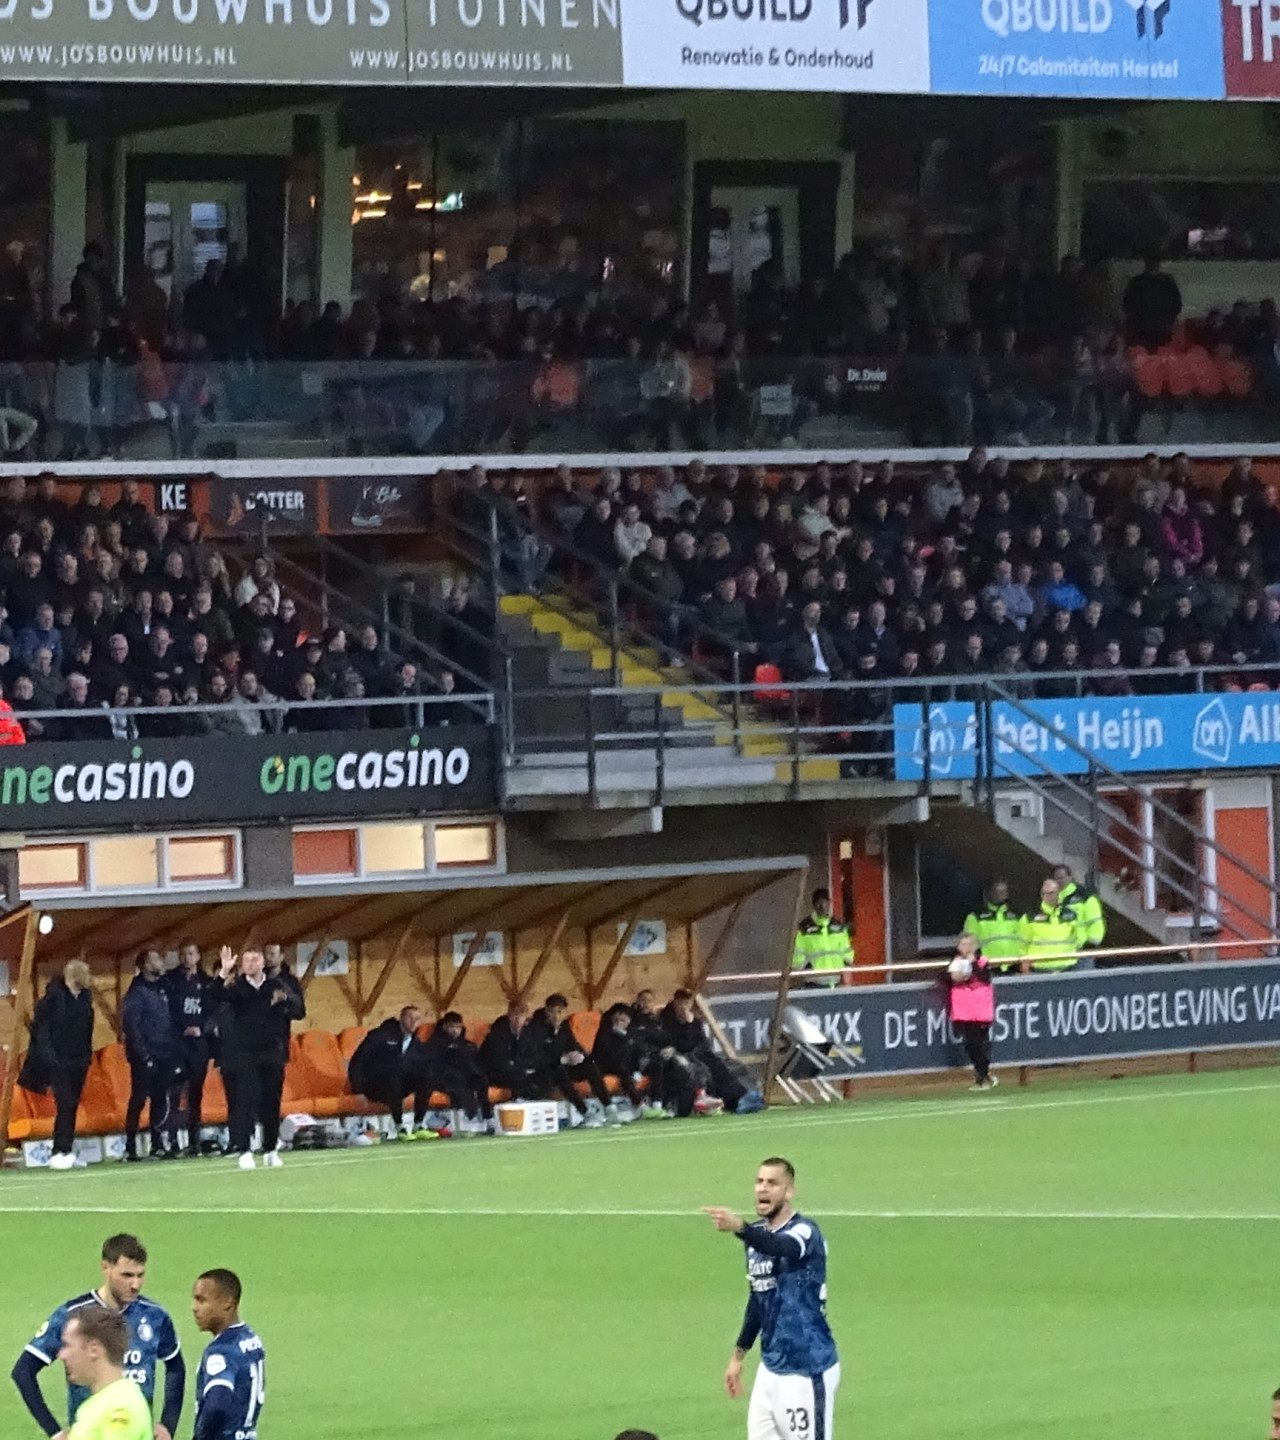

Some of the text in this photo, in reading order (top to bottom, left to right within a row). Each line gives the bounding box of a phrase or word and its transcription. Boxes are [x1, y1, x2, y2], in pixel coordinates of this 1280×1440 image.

[981, 0, 1112, 36] QBUILD
[681, 46, 873, 69] Renovatie & Onderhoud
[161, 484, 187, 510] KE
[962, 714, 1066, 756] Abert
[1077, 708, 1164, 760] Heijn
[260, 734, 470, 796] onecasino
[885, 1010, 917, 1049] DE
[927, 1001, 1040, 1045] MSTE
[1046, 985, 1246, 1037] WOONBELEVING
